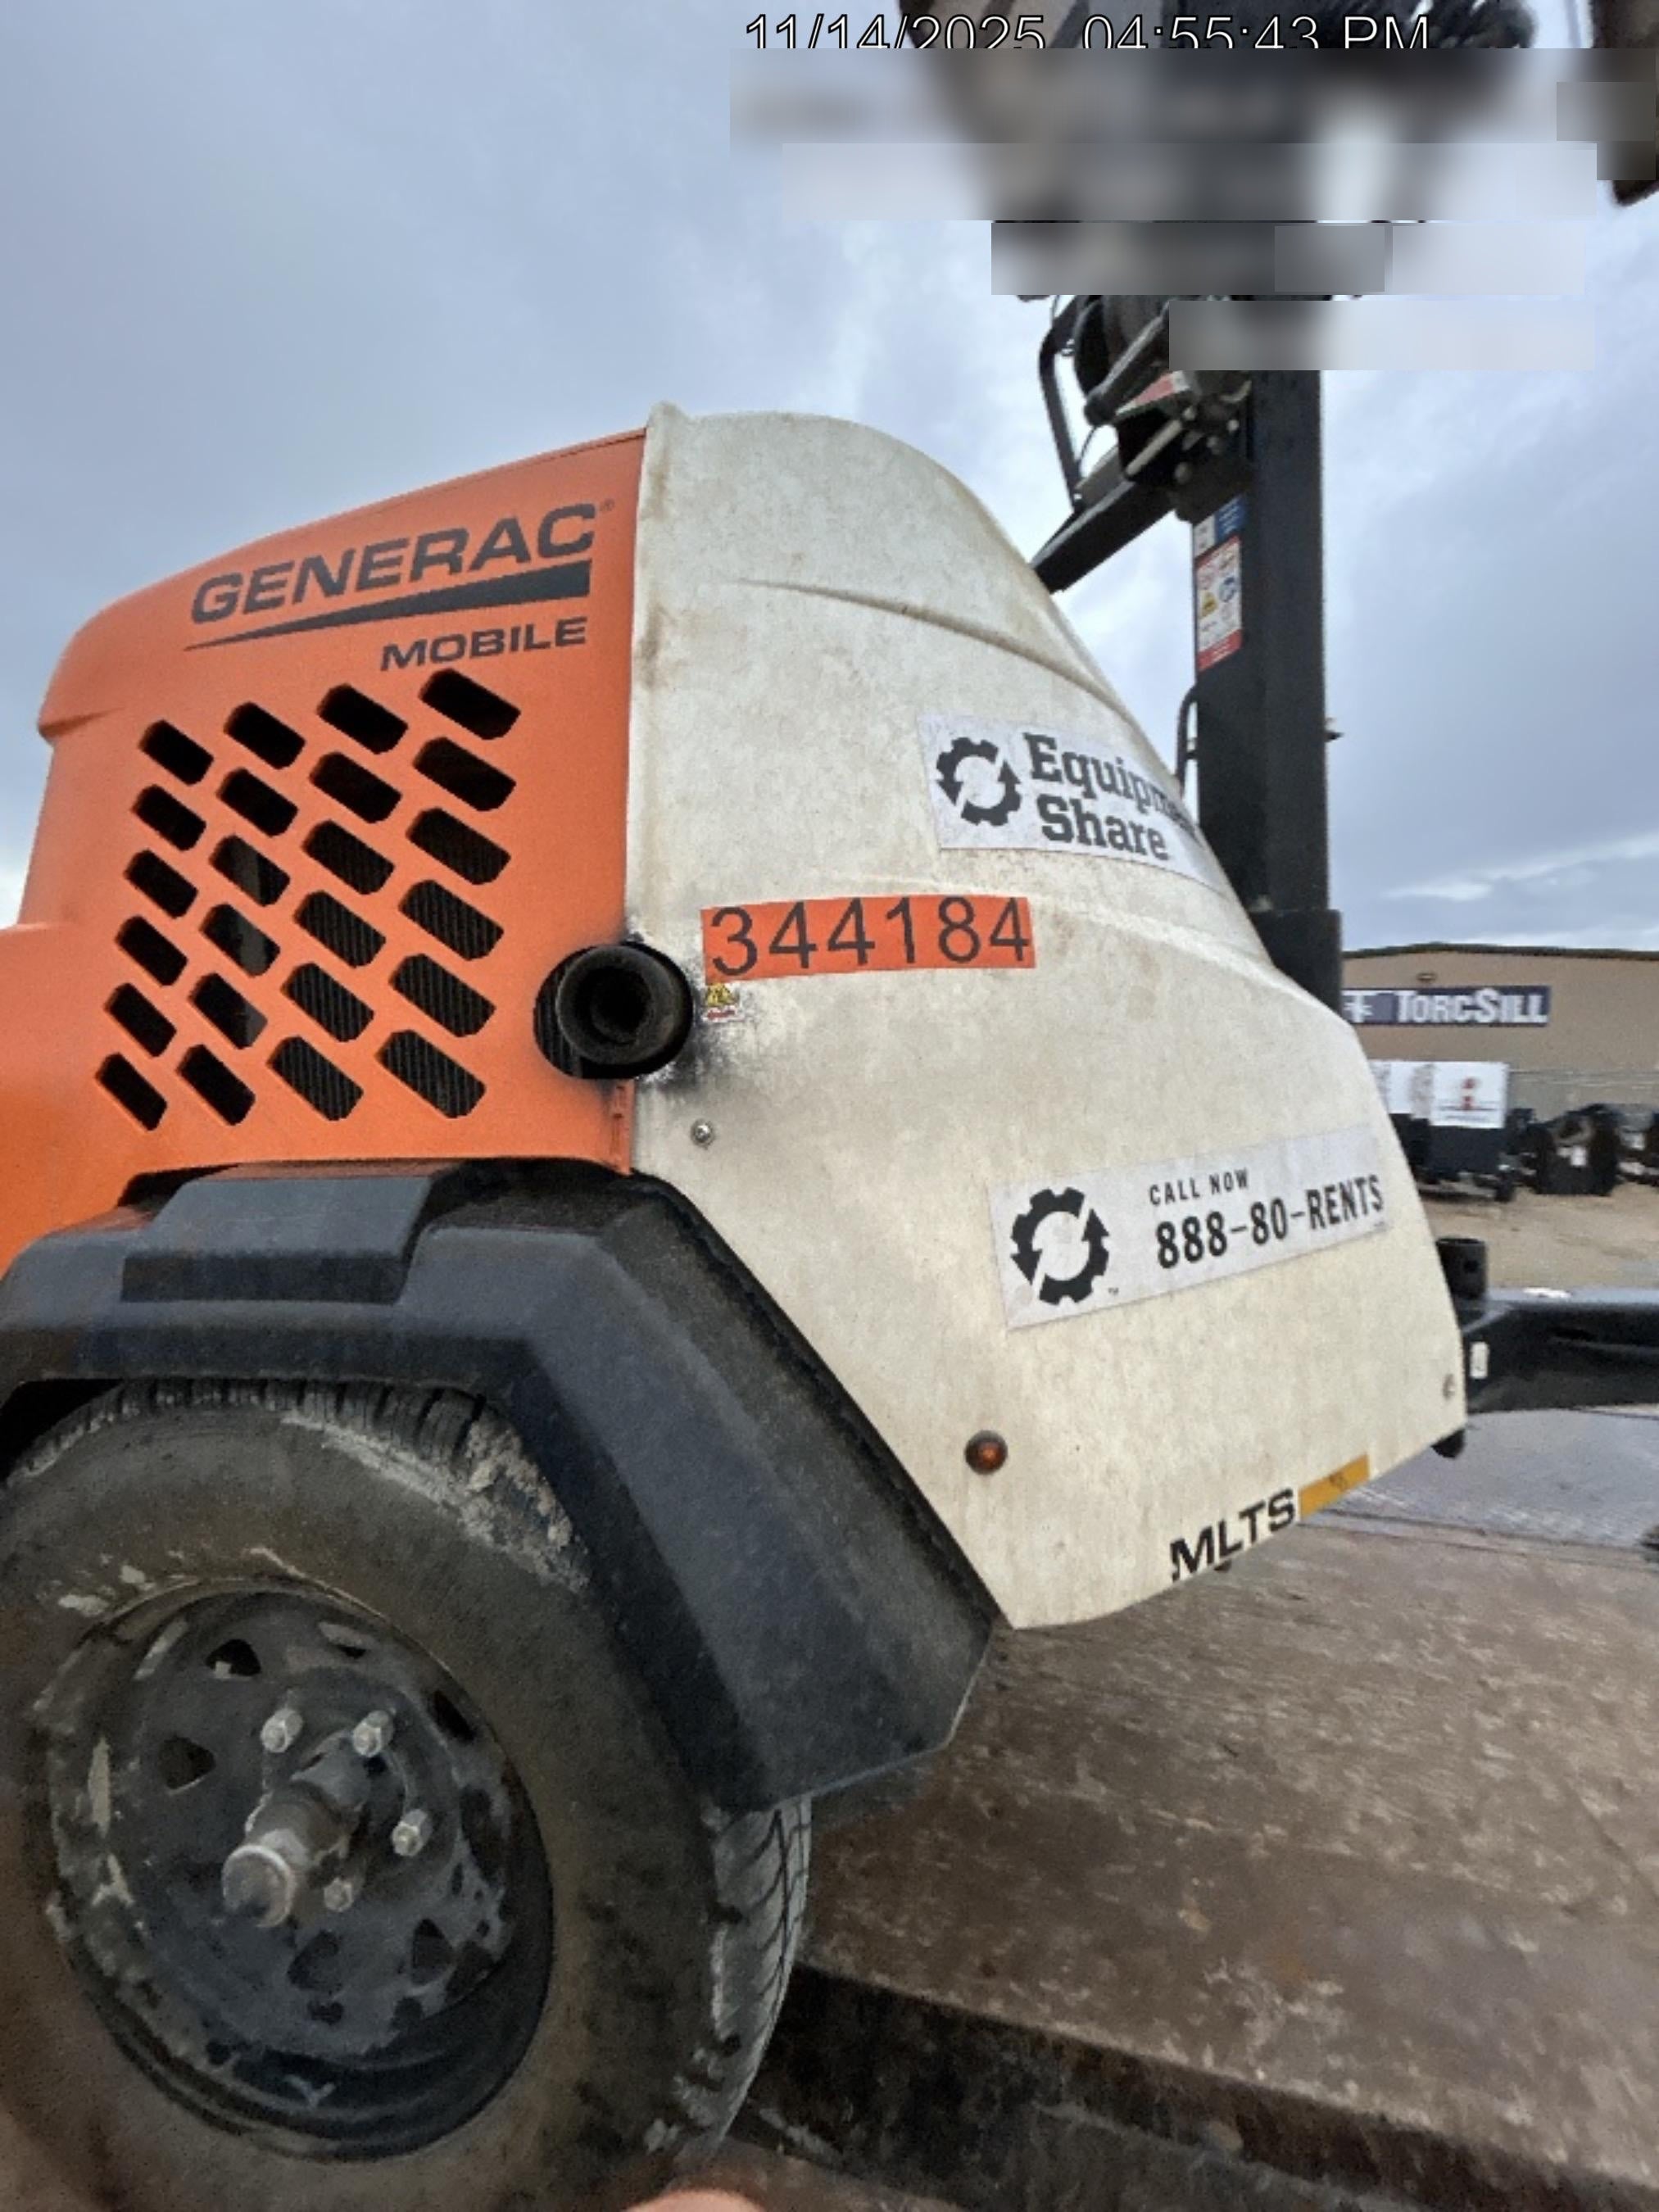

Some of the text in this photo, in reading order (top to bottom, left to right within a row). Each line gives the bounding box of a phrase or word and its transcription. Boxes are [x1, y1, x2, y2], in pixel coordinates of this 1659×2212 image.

[191, 503, 596, 624] GENERAC
[380, 617, 588, 671] MOBILE
[1036, 793, 1169, 861] Share
[710, 895, 1030, 977] 344184
[1148, 1167, 1249, 1207] CALL NOW
[1155, 1173, 1385, 1270] 888-80-RENTS
[1169, 1487, 1296, 1583] MLTS
